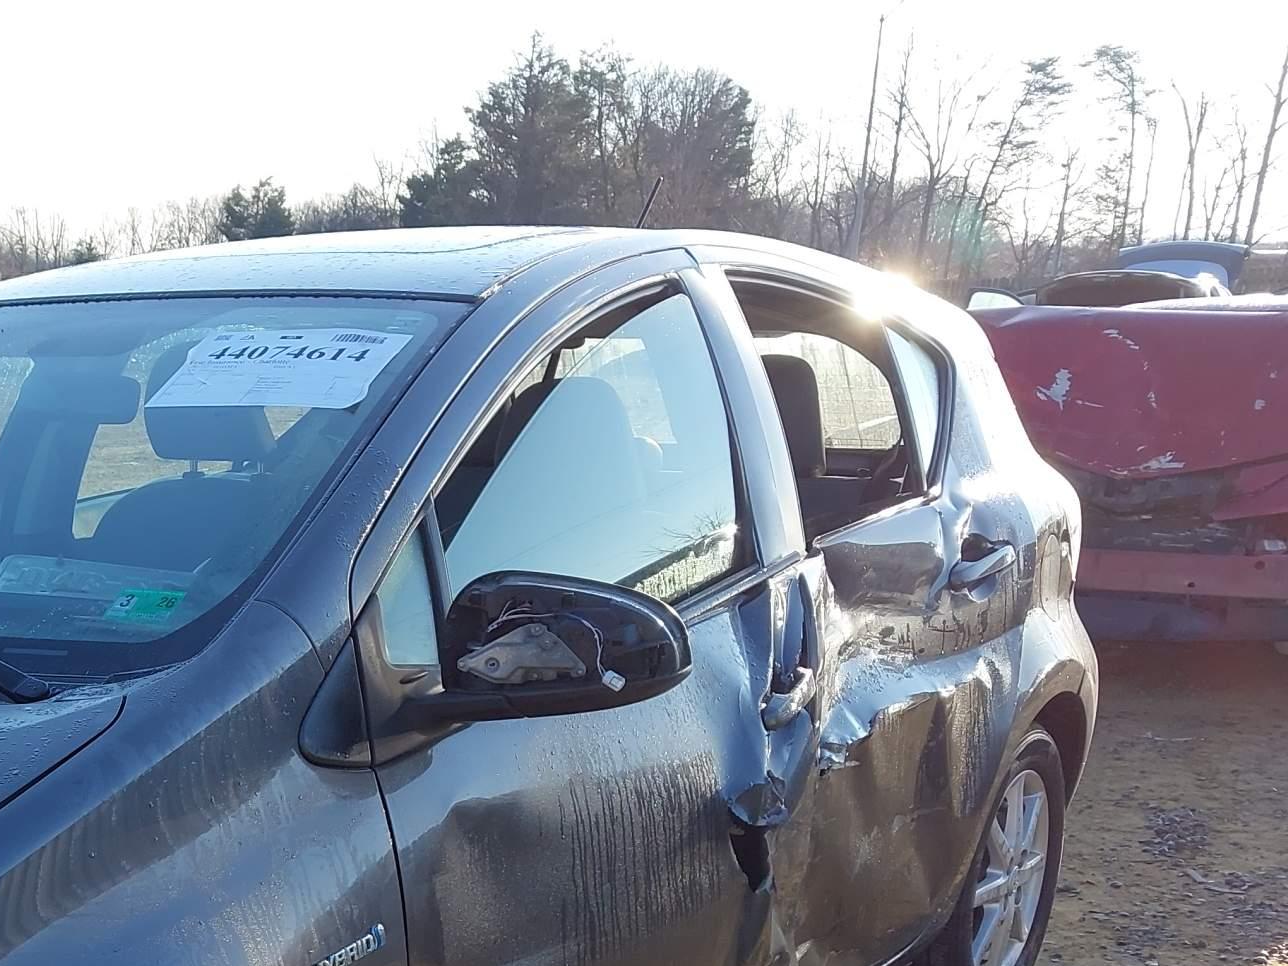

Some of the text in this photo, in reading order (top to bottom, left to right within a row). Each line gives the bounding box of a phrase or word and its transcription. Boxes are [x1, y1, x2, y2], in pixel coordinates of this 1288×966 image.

[208, 345, 371, 362] 44074614
[119, 594, 178, 608] 3 26
